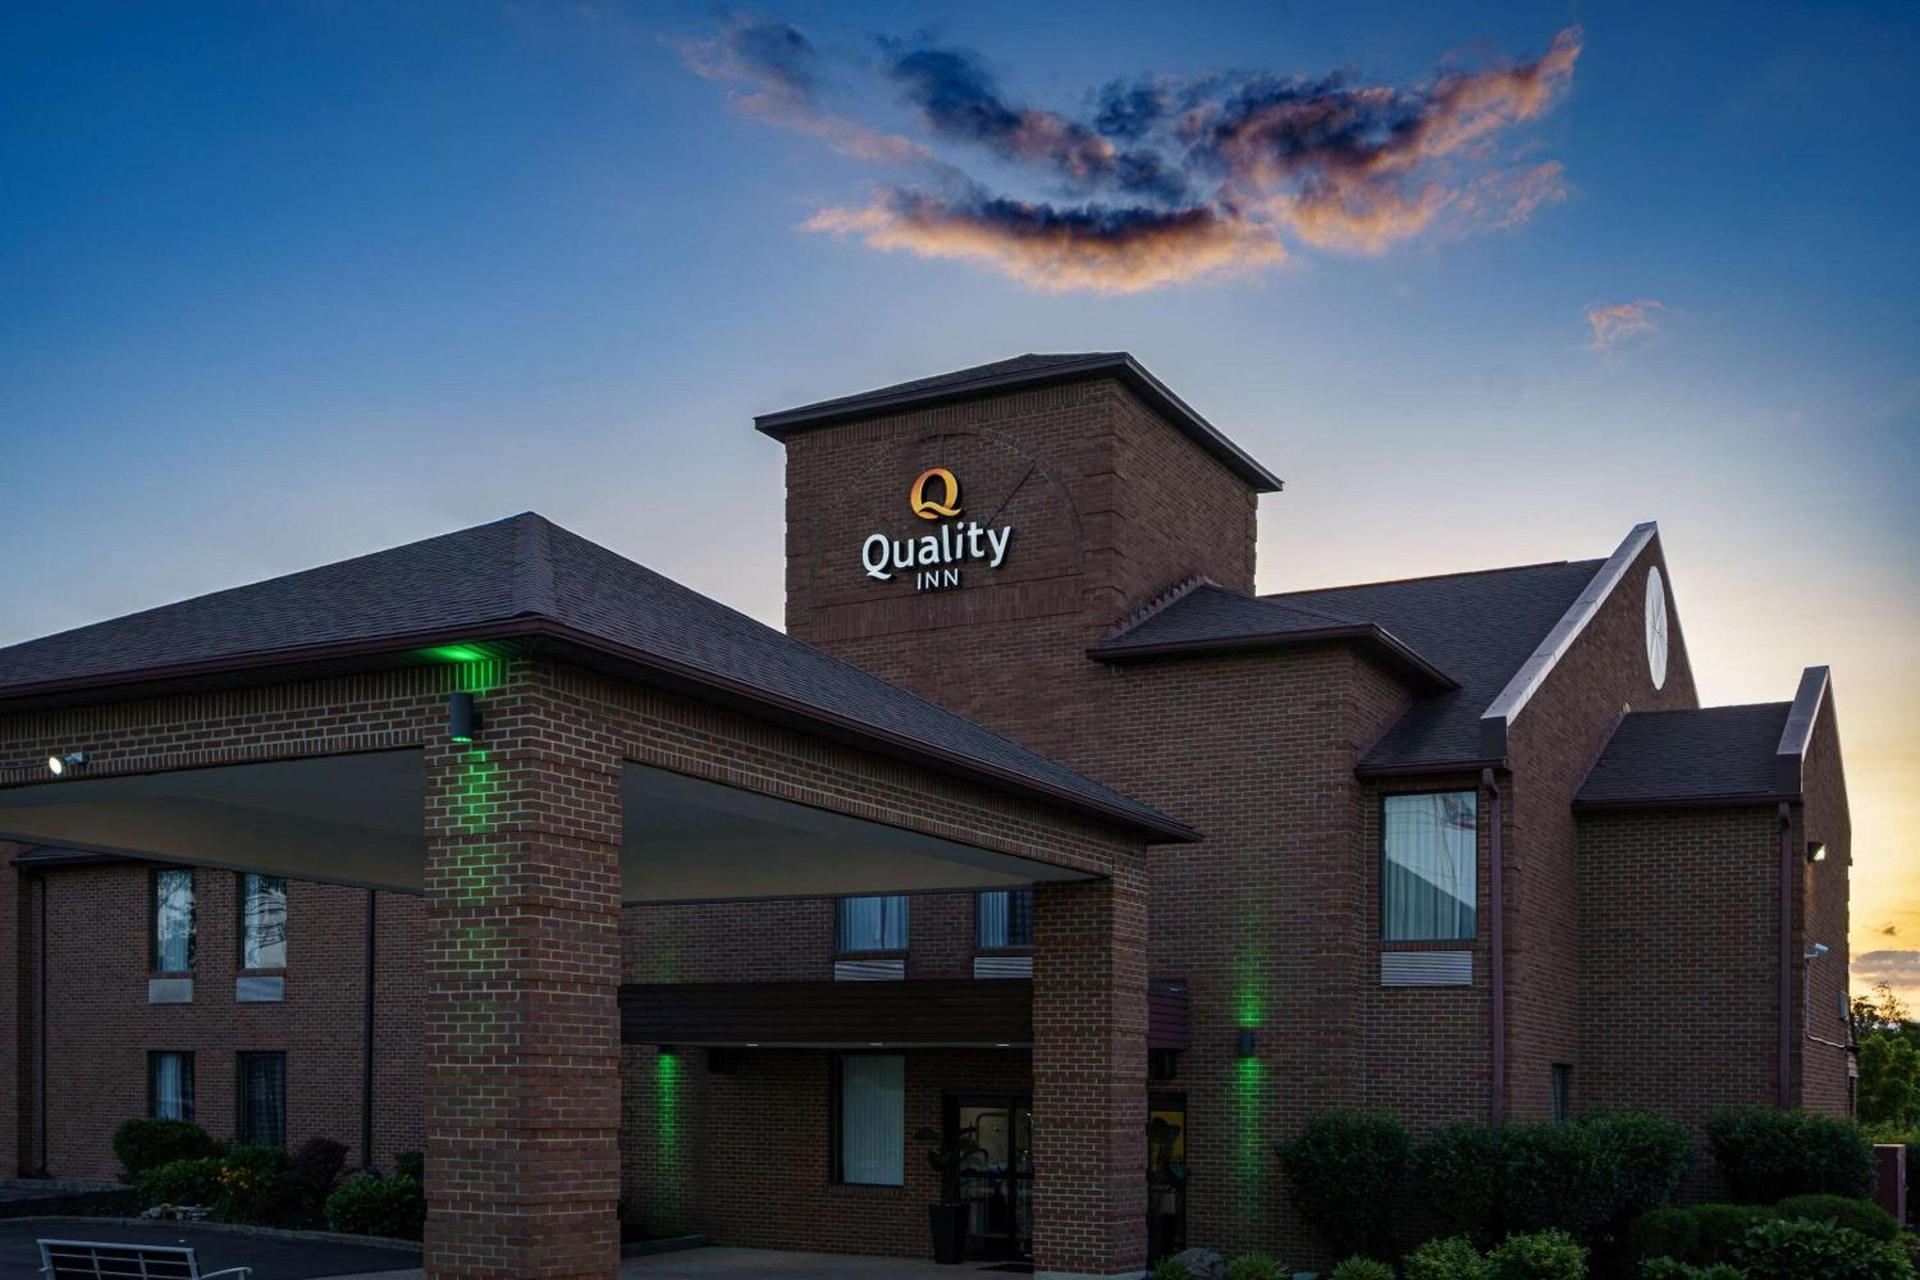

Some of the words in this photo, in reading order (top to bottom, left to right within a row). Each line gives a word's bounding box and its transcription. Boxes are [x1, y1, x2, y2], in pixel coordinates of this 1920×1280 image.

[910, 467, 962, 520] Q
[862, 521, 1012, 580] Quality
[917, 568, 959, 590] INN
